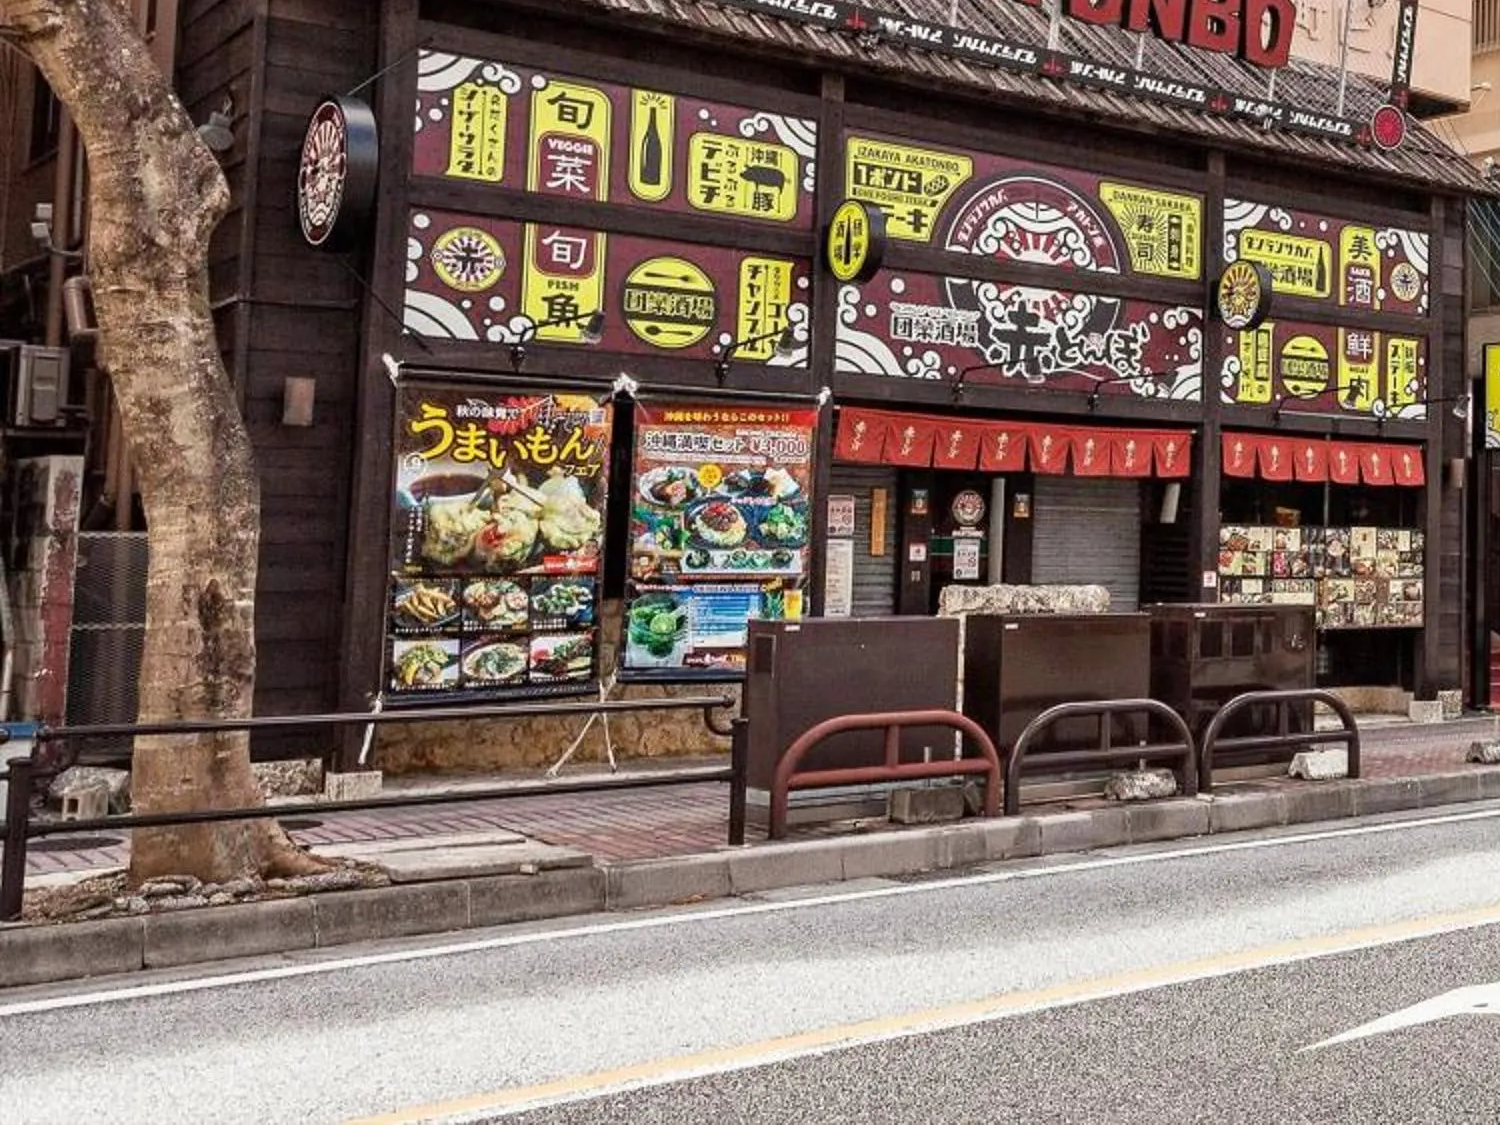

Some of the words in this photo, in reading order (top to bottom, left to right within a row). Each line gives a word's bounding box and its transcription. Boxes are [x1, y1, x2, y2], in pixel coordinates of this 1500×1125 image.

[547, 91, 596, 130] 旬
[699, 140, 723, 205] テビチ
[858, 146, 900, 162] IZAKAYA
[546, 155, 592, 194] 菜
[541, 230, 589, 270] 旬
[1348, 235, 1373, 261] 美
[1347, 276, 1373, 304] 酒
[538, 292, 586, 330] 魚
[988, 290, 1149, 383] 赤とんぼ
[1347, 332, 1373, 361] 鮮
[411, 402, 595, 468] うまいもん
